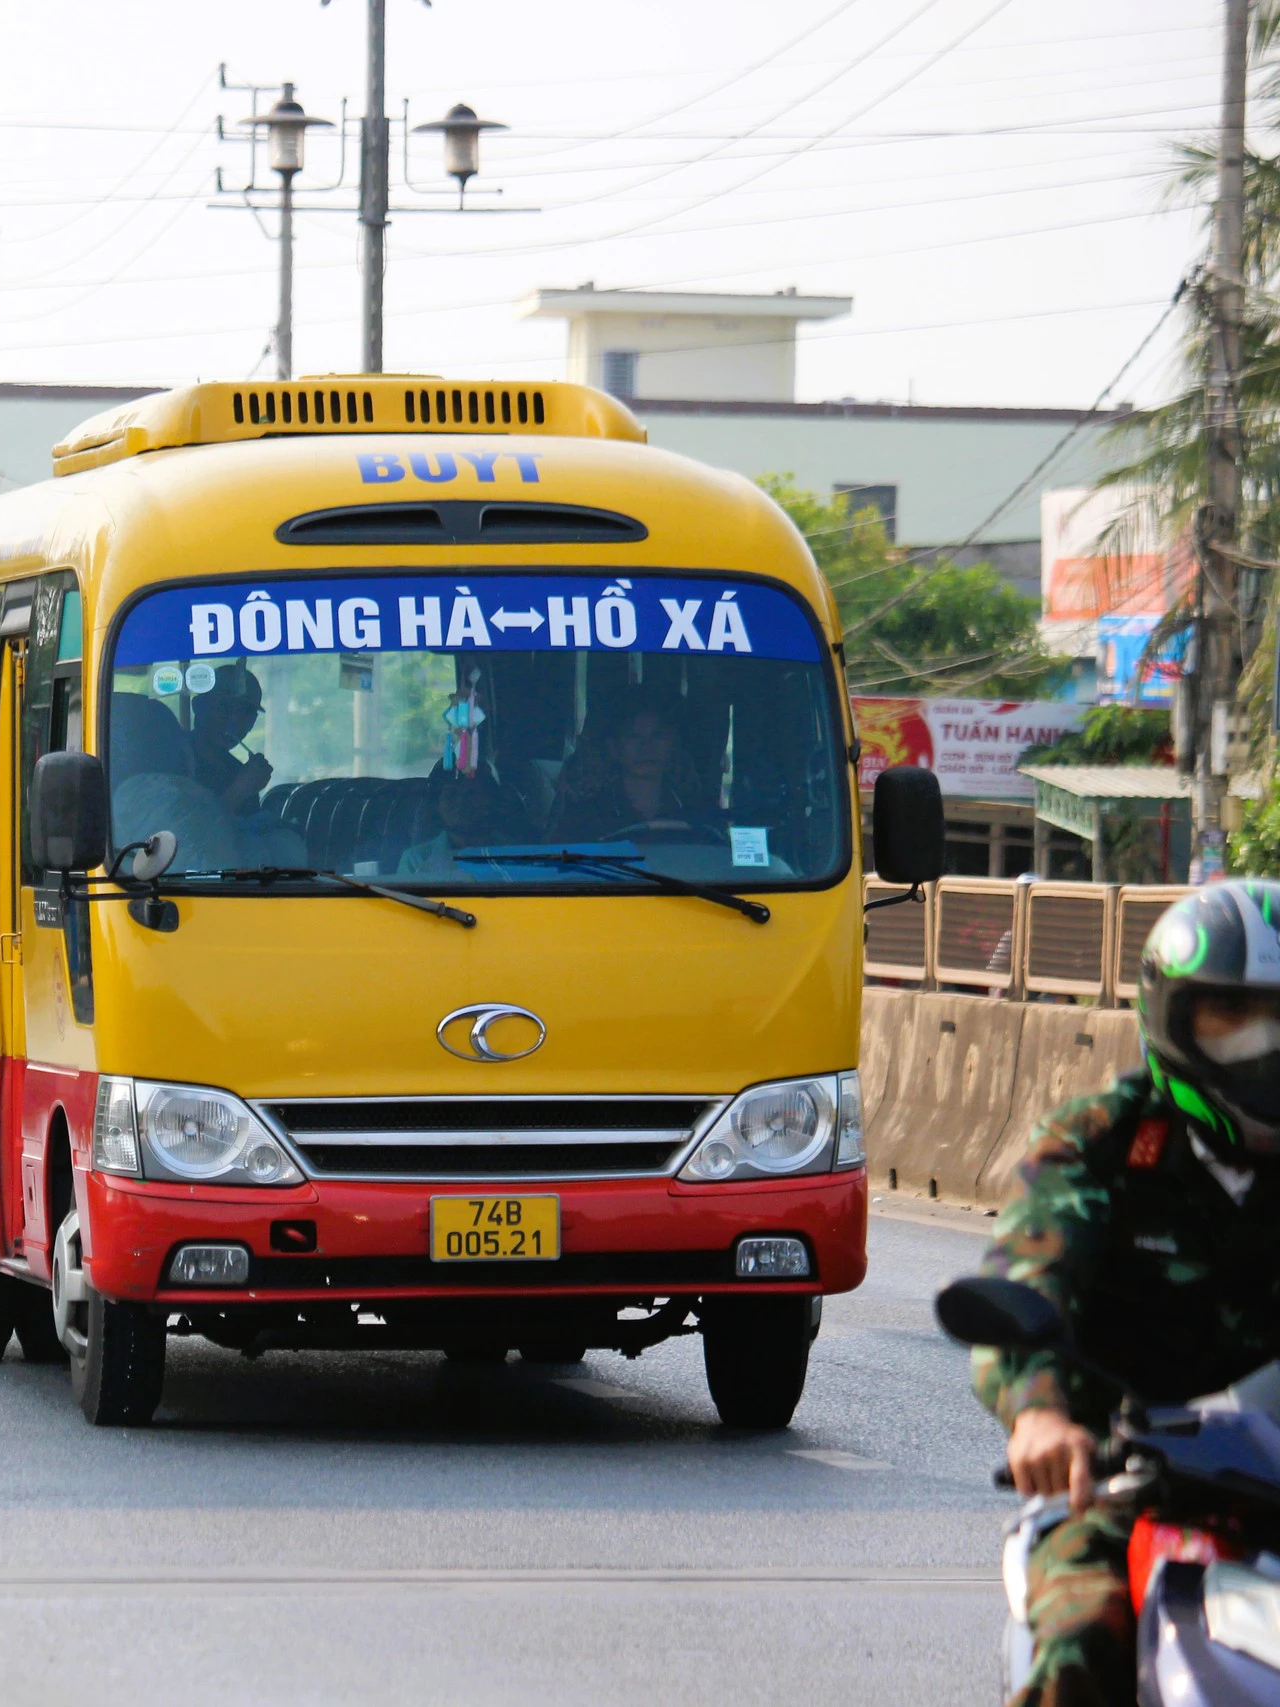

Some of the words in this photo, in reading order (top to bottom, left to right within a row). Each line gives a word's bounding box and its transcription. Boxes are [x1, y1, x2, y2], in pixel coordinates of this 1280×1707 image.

[189, 590, 381, 654] ĐÔNG
[398, 585, 493, 648] HÀ
[547, 578, 638, 648] HỒ
[659, 590, 753, 653] XÁ
[468, 1200, 522, 1227] 74B
[446, 1230, 542, 1256] 005.21
